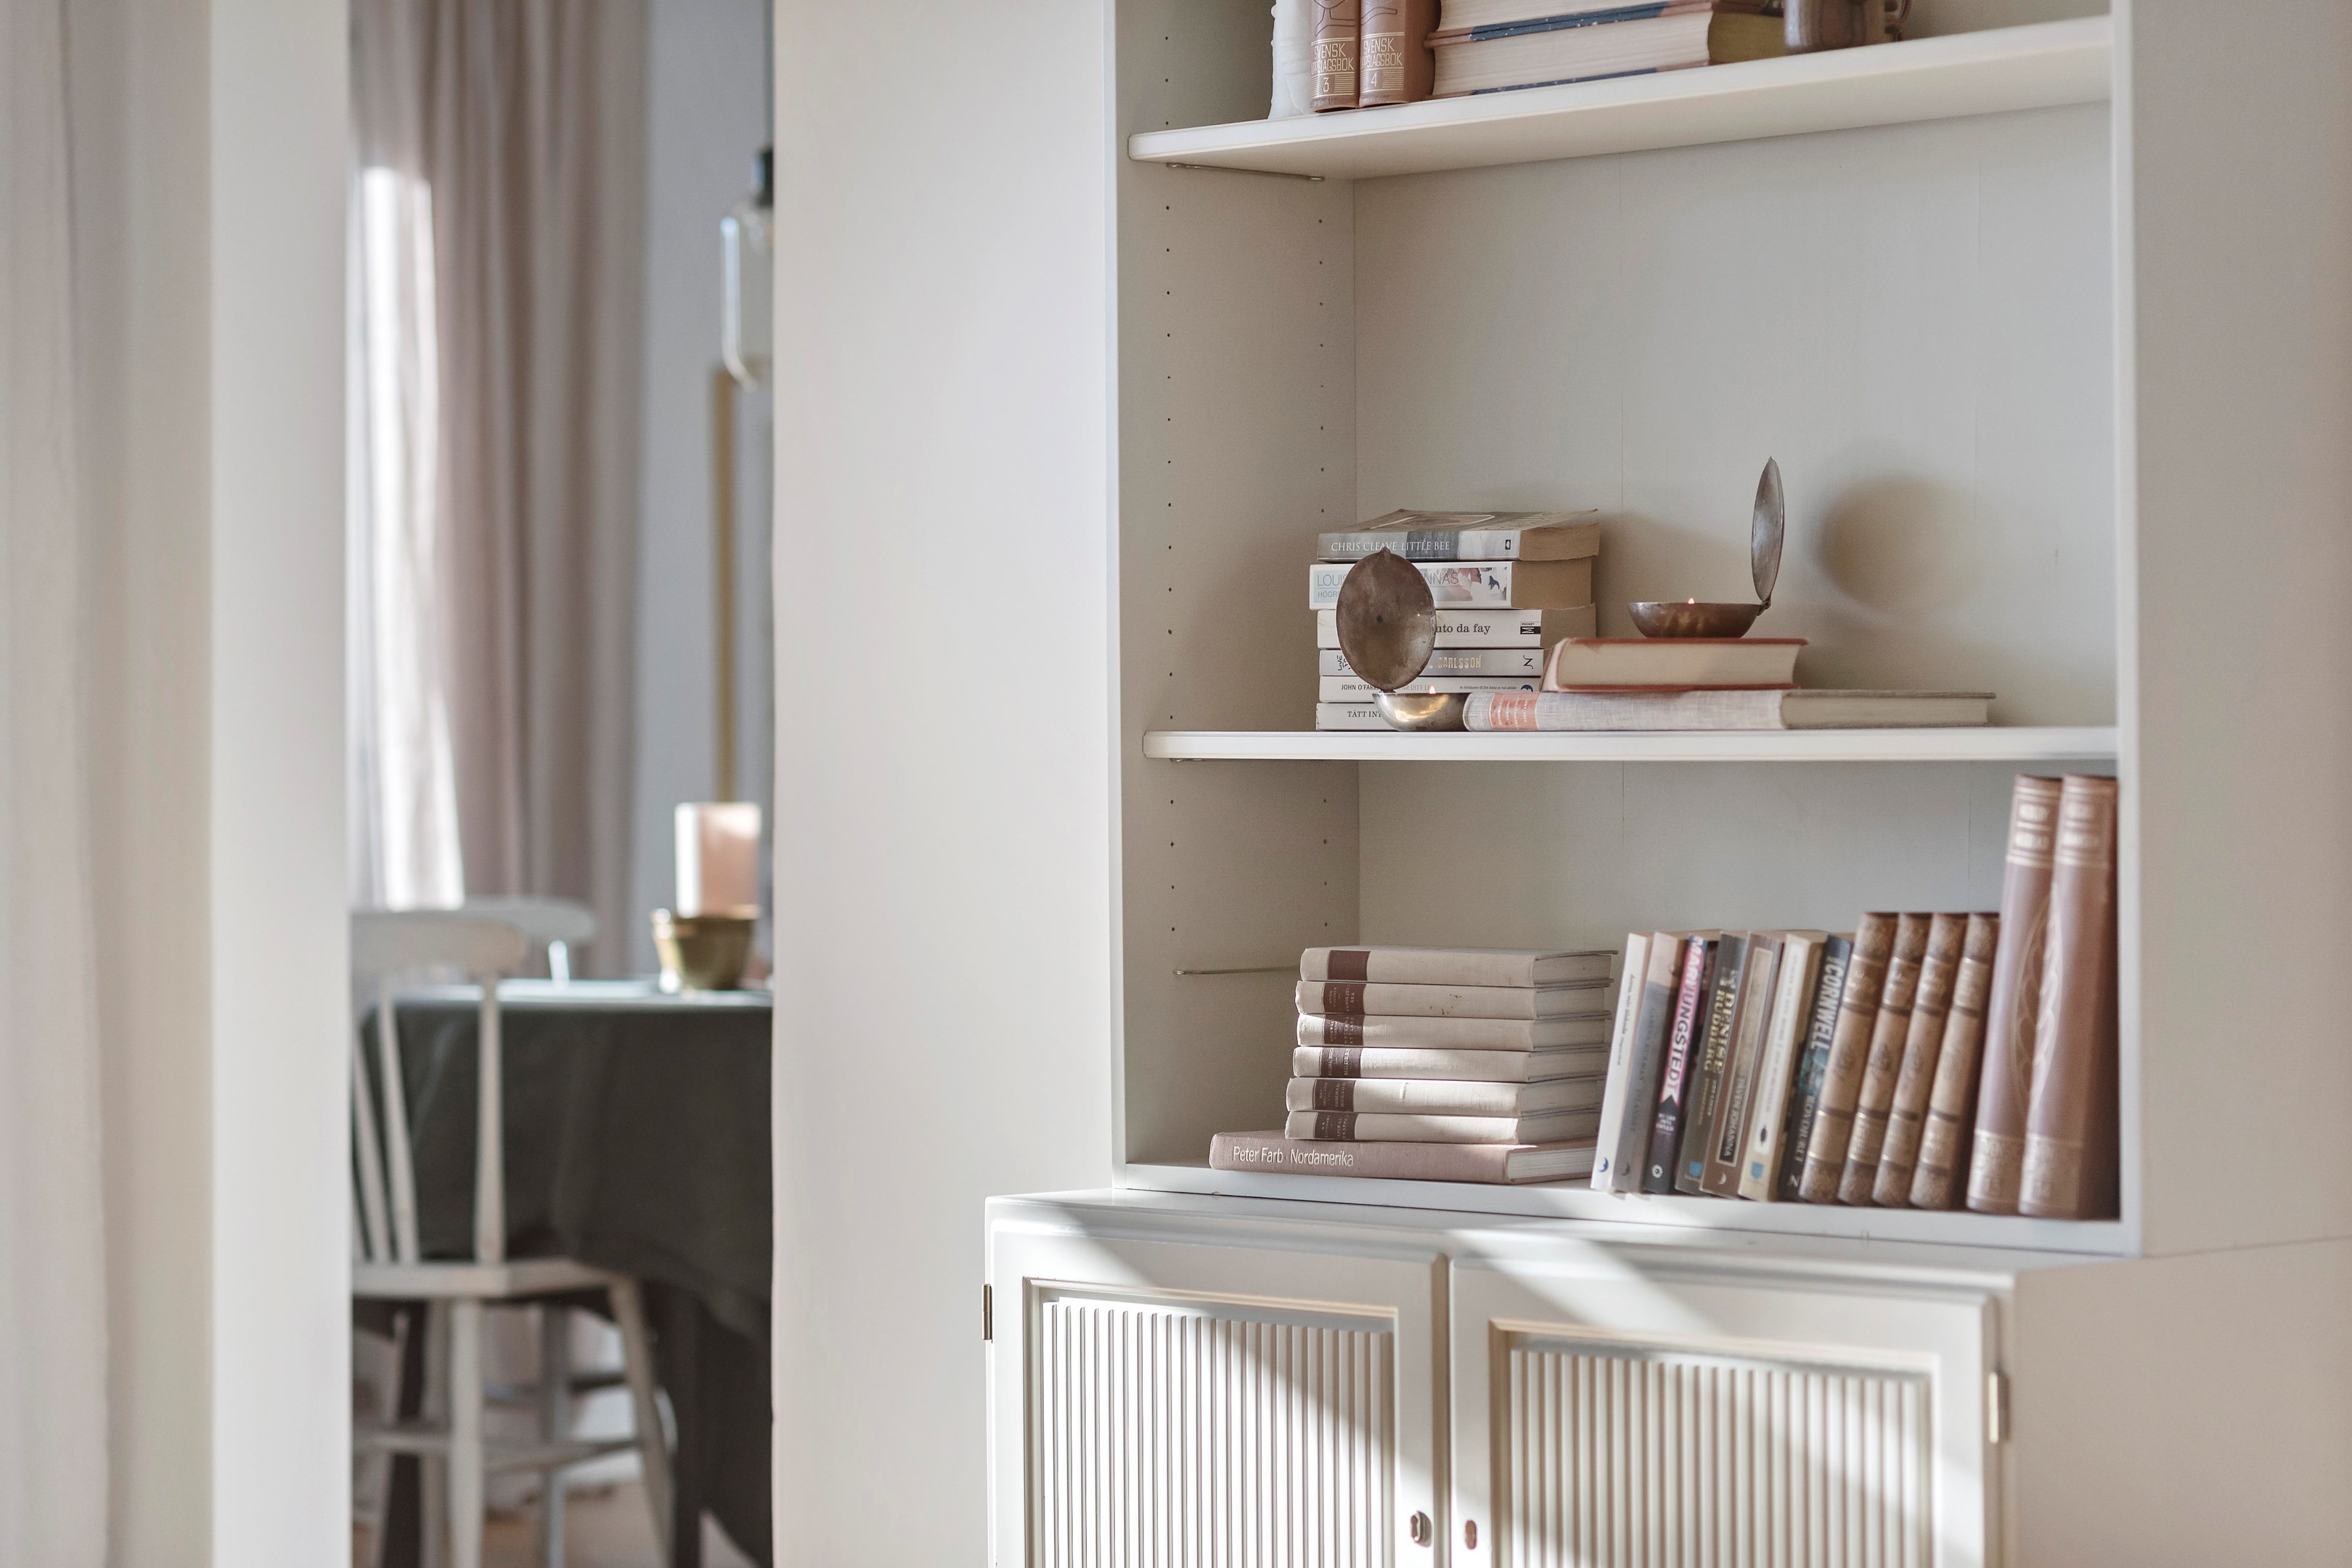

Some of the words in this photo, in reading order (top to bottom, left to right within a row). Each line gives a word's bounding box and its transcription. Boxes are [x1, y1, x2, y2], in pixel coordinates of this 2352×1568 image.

[1314, 44, 1346, 60] SVENSK
[1363, 38, 1395, 54] SVENSK
[1311, 58, 1355, 75] UPPSLAGSBOK
[1360, 53, 1402, 69] UPPSLAGSBOK
[1323, 77, 1329, 92] 3
[1371, 73, 1377, 87] 4
[1331, 543, 1360, 552] CHRIS
[1363, 542, 1397, 551] CLEAVE
[1401, 541, 1431, 551] LITTLE
[1434, 541, 1450, 550] BEE
[1456, 624, 1470, 633] da
[1473, 623, 1491, 634] fay
[1347, 709, 1367, 718] TÄTT
[1686, 935, 1704, 985] MARI
[1810, 963, 1845, 1051] CORNWELL
[1668, 984, 1696, 1093] JUNGSTEDT
[1233, 1146, 1259, 1161] Peter
[1261, 1147, 1283, 1163] Farb
[1290, 1148, 1354, 1167] Nordamerika
